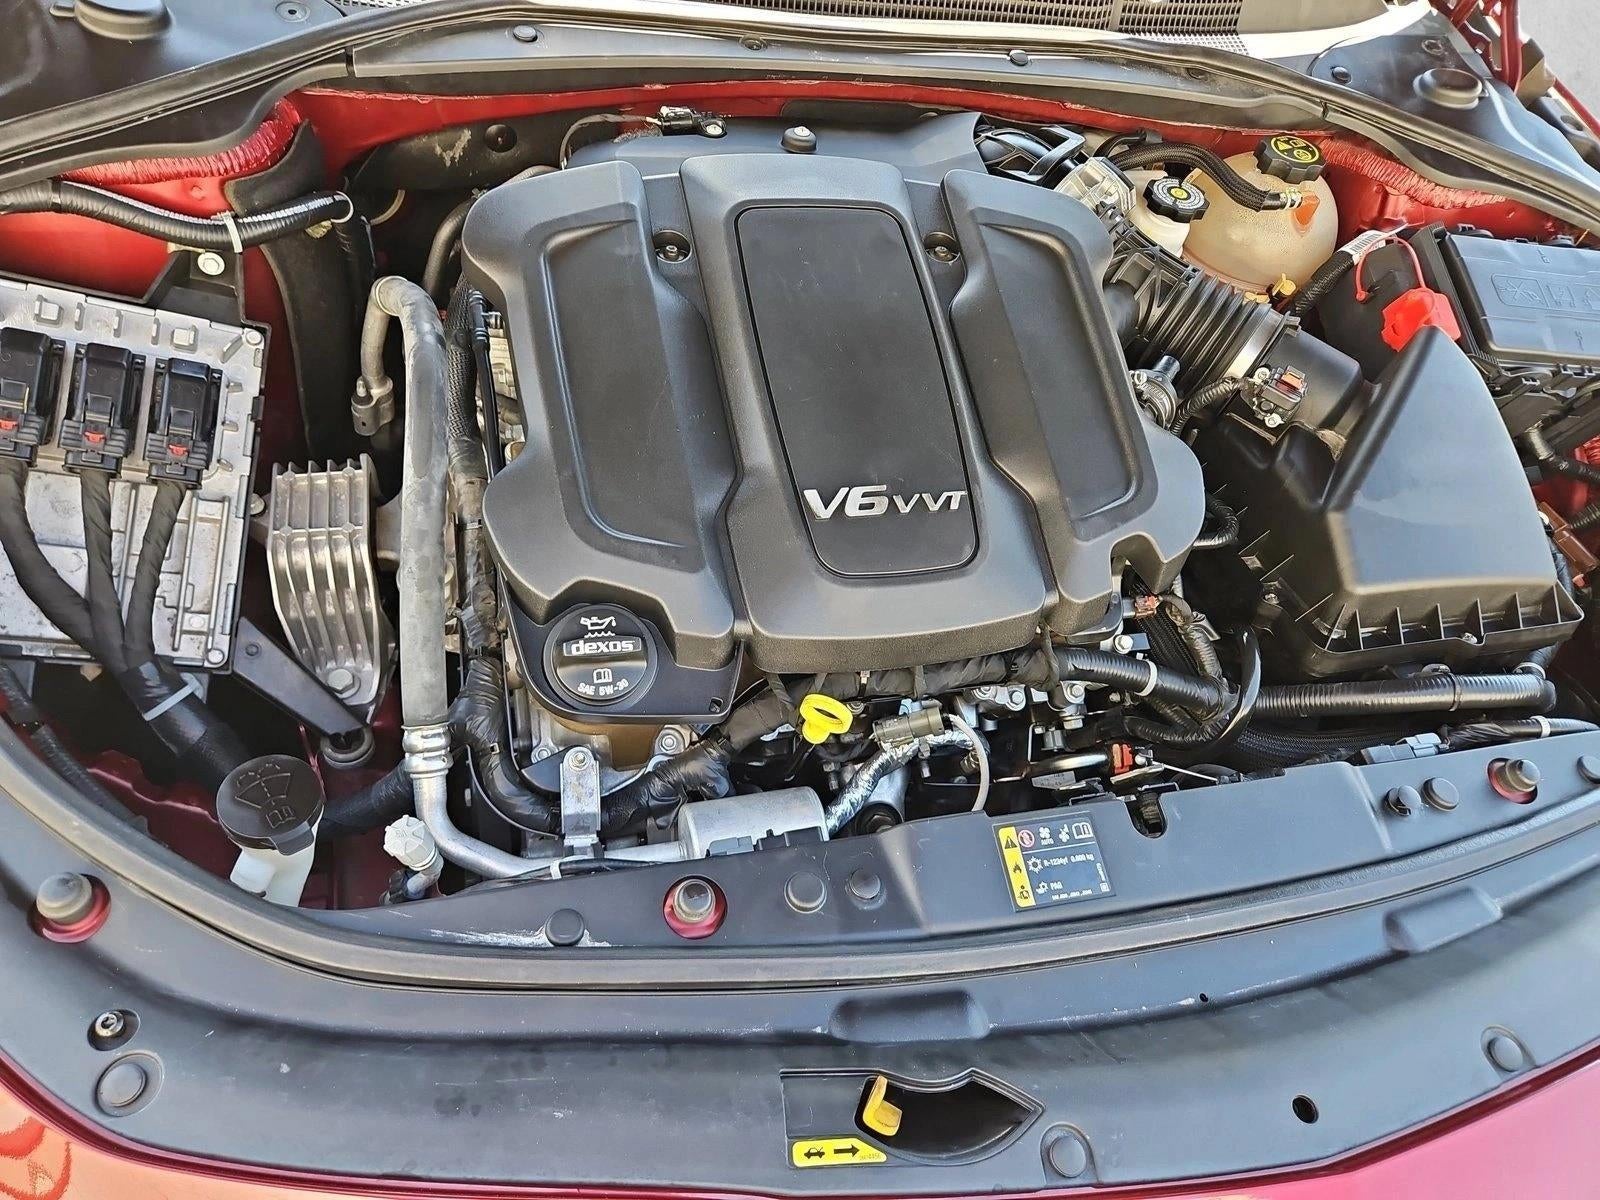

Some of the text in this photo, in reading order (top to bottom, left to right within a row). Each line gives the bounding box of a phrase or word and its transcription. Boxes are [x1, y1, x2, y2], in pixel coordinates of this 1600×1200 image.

[803, 484, 968, 521] V6 VVT
[571, 639, 636, 656] dexos
[577, 678, 629, 696] SAE 5W-30
